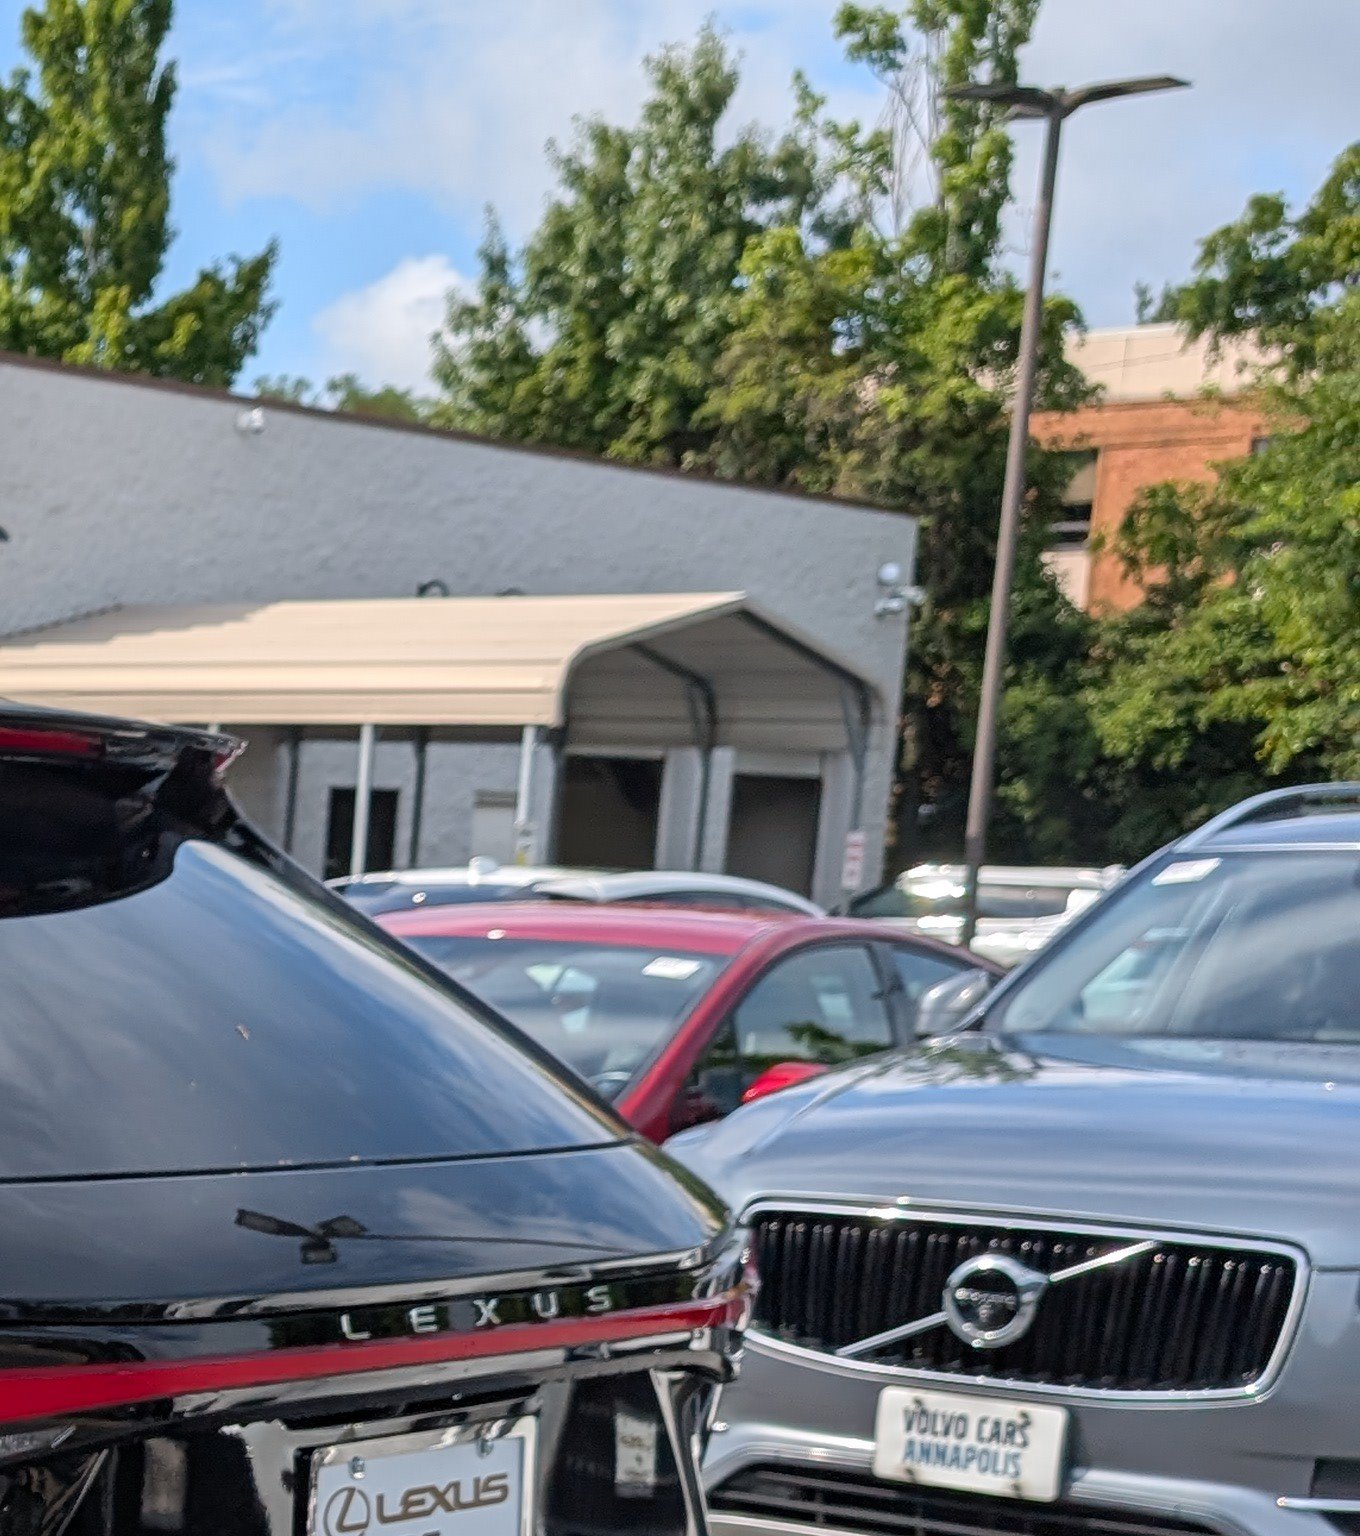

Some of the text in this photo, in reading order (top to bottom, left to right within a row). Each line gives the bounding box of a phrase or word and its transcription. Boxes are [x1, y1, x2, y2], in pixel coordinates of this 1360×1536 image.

[340, 1285, 613, 1341] LEXUS
[903, 1405, 1030, 1448] VOLVO CARS
[903, 1437, 1022, 1479] ANNAPOLIS
[375, 1471, 510, 1525] LEXUS
